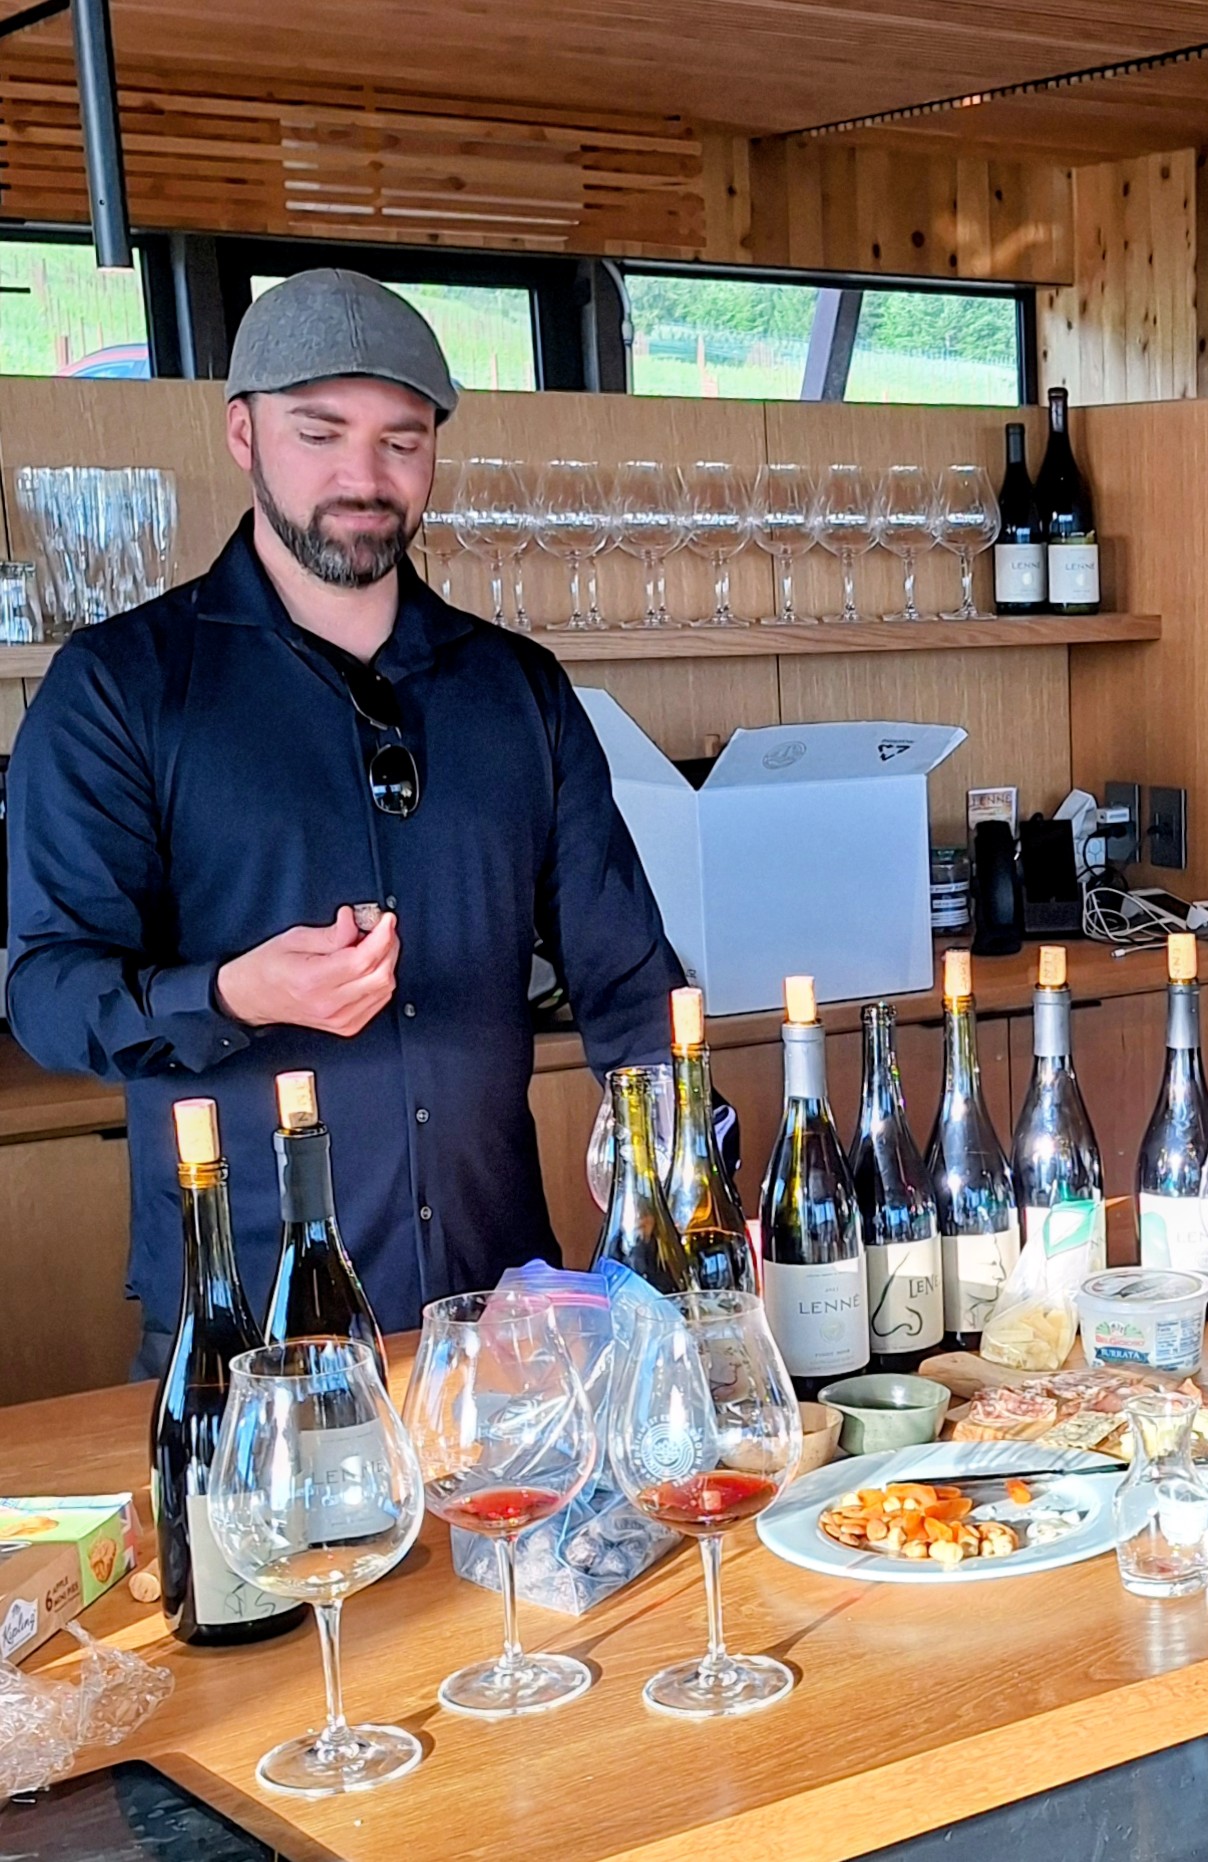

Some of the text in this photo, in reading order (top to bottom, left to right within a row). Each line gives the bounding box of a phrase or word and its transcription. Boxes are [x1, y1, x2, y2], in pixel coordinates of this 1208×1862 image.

[798, 1293, 862, 1315] LENNÉ
[1100, 1347, 1141, 1360] BURRATA
[45, 1589, 53, 1613] 6
